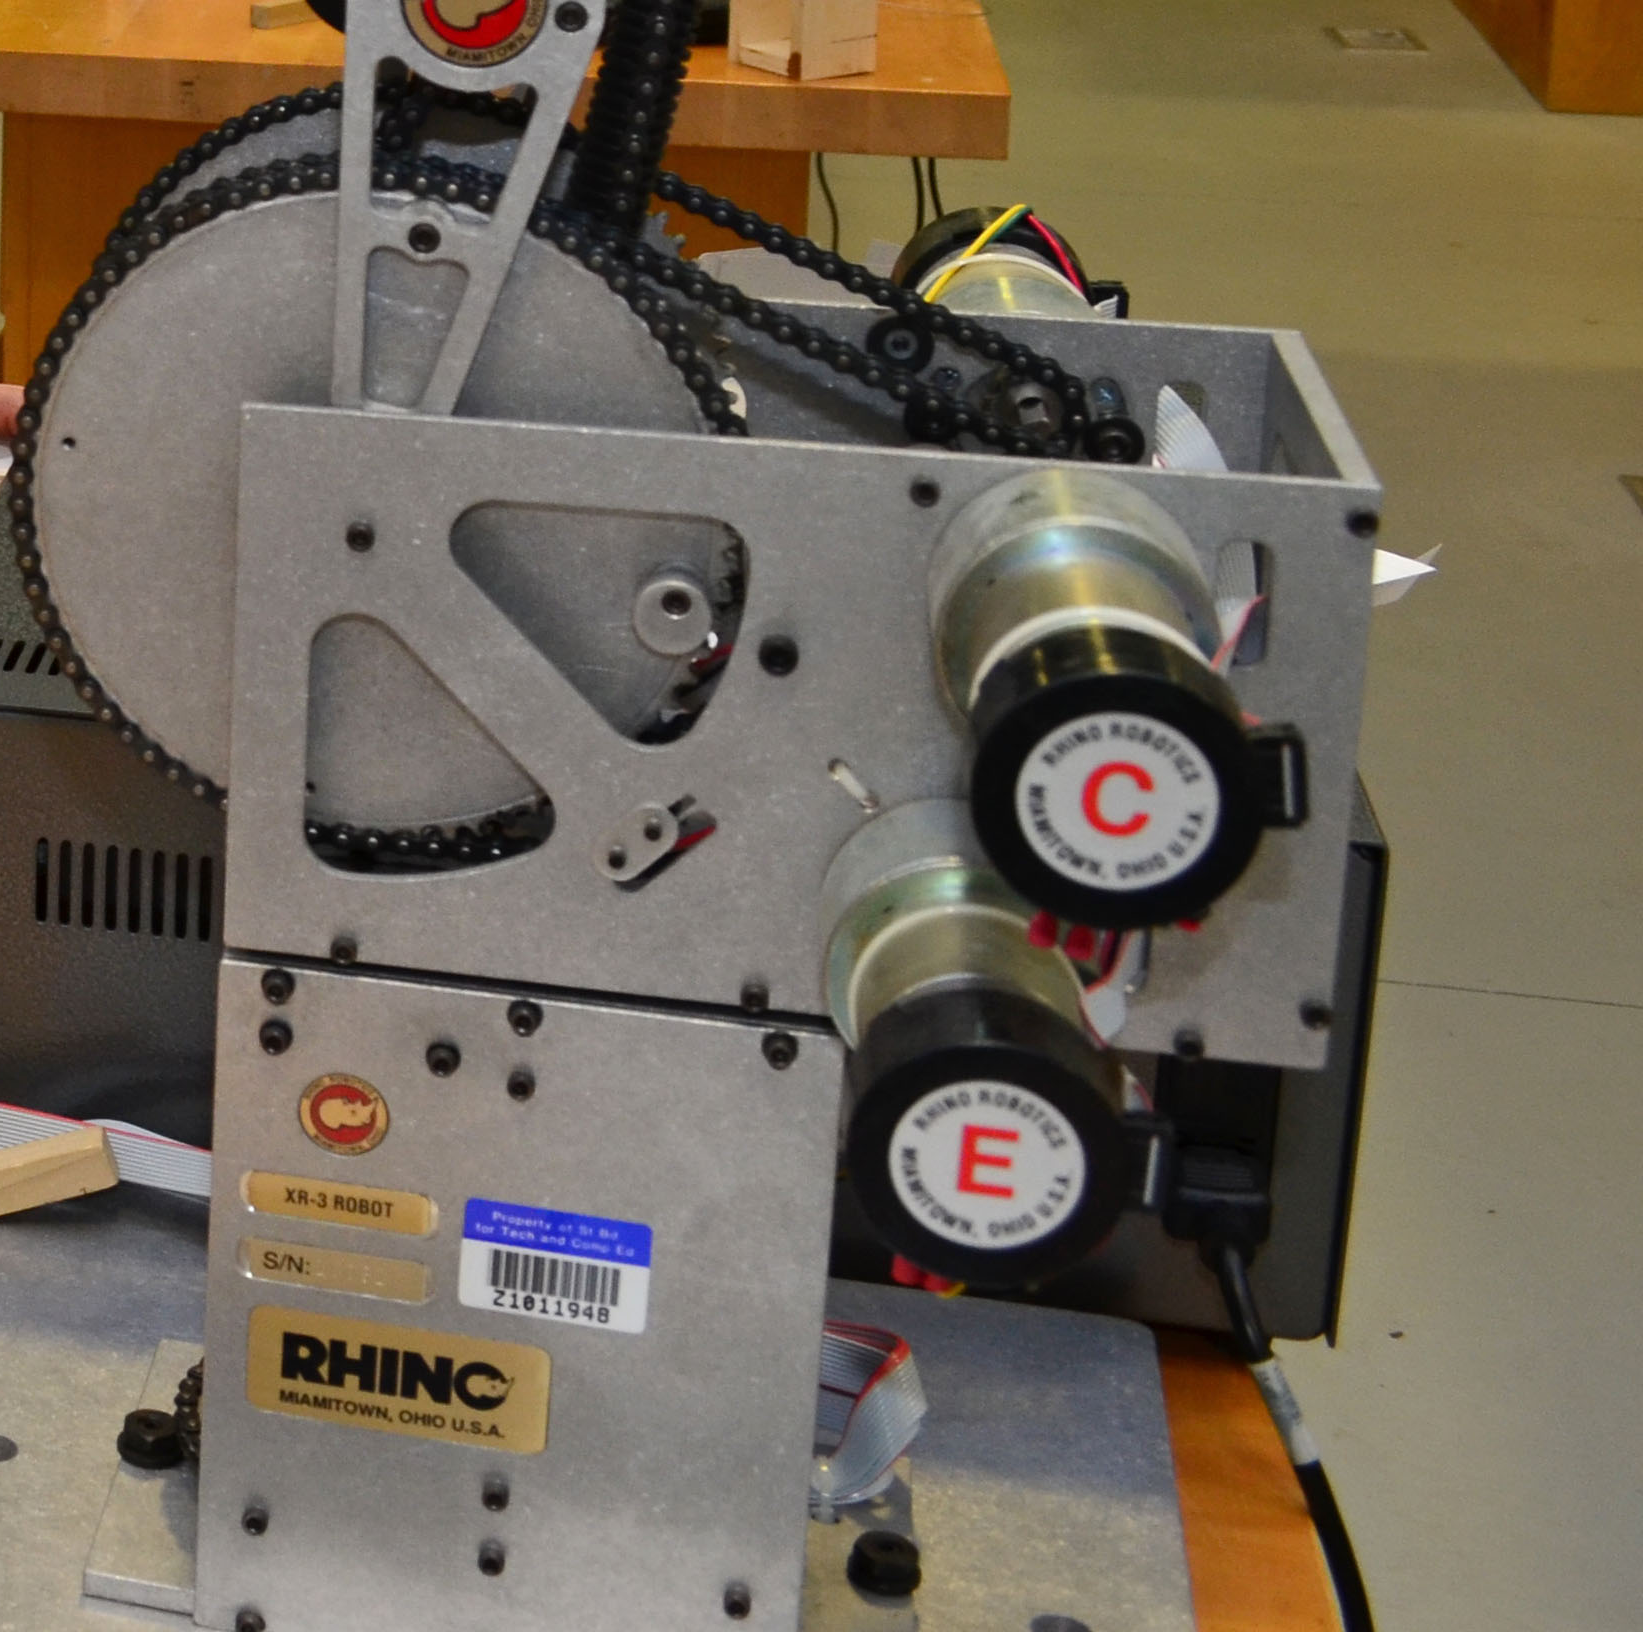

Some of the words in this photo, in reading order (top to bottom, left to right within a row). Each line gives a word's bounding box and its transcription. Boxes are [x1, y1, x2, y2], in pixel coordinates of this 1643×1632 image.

[446, 32, 527, 62] MIAMITOWN
[1042, 724, 1103, 768] RHINO
[1110, 721, 1202, 785] ROBOTICS
[1082, 760, 1155, 838] C
[1116, 852, 1168, 880] OHIO
[913, 1090, 972, 1131] RHINO
[977, 1088, 1066, 1150] ROBOTICS
[957, 1124, 1022, 1199] E
[284, 1187, 328, 1209] XR-3
[333, 1194, 395, 1218] ROBOT
[475, 1221, 495, 1235] for
[502, 1225, 535, 1241] Tech
[540, 1233, 566, 1247] and
[571, 1237, 611, 1255] Comp
[616, 1245, 636, 1258] Ed
[491, 1210, 552, 1231] Property
[558, 1223, 573, 1233] of
[579, 1224, 593, 1237] St
[599, 1227, 619, 1241] Bd
[987, 1213, 1037, 1238] OHIO
[263, 1250, 311, 1276] S/N:
[492, 1288, 611, 1325] Z1011948
[278, 1388, 394, 1423] MIAMITOWN,
[398, 1409, 446, 1429] OHIO
[451, 1418, 506, 1439] U.S.A.
